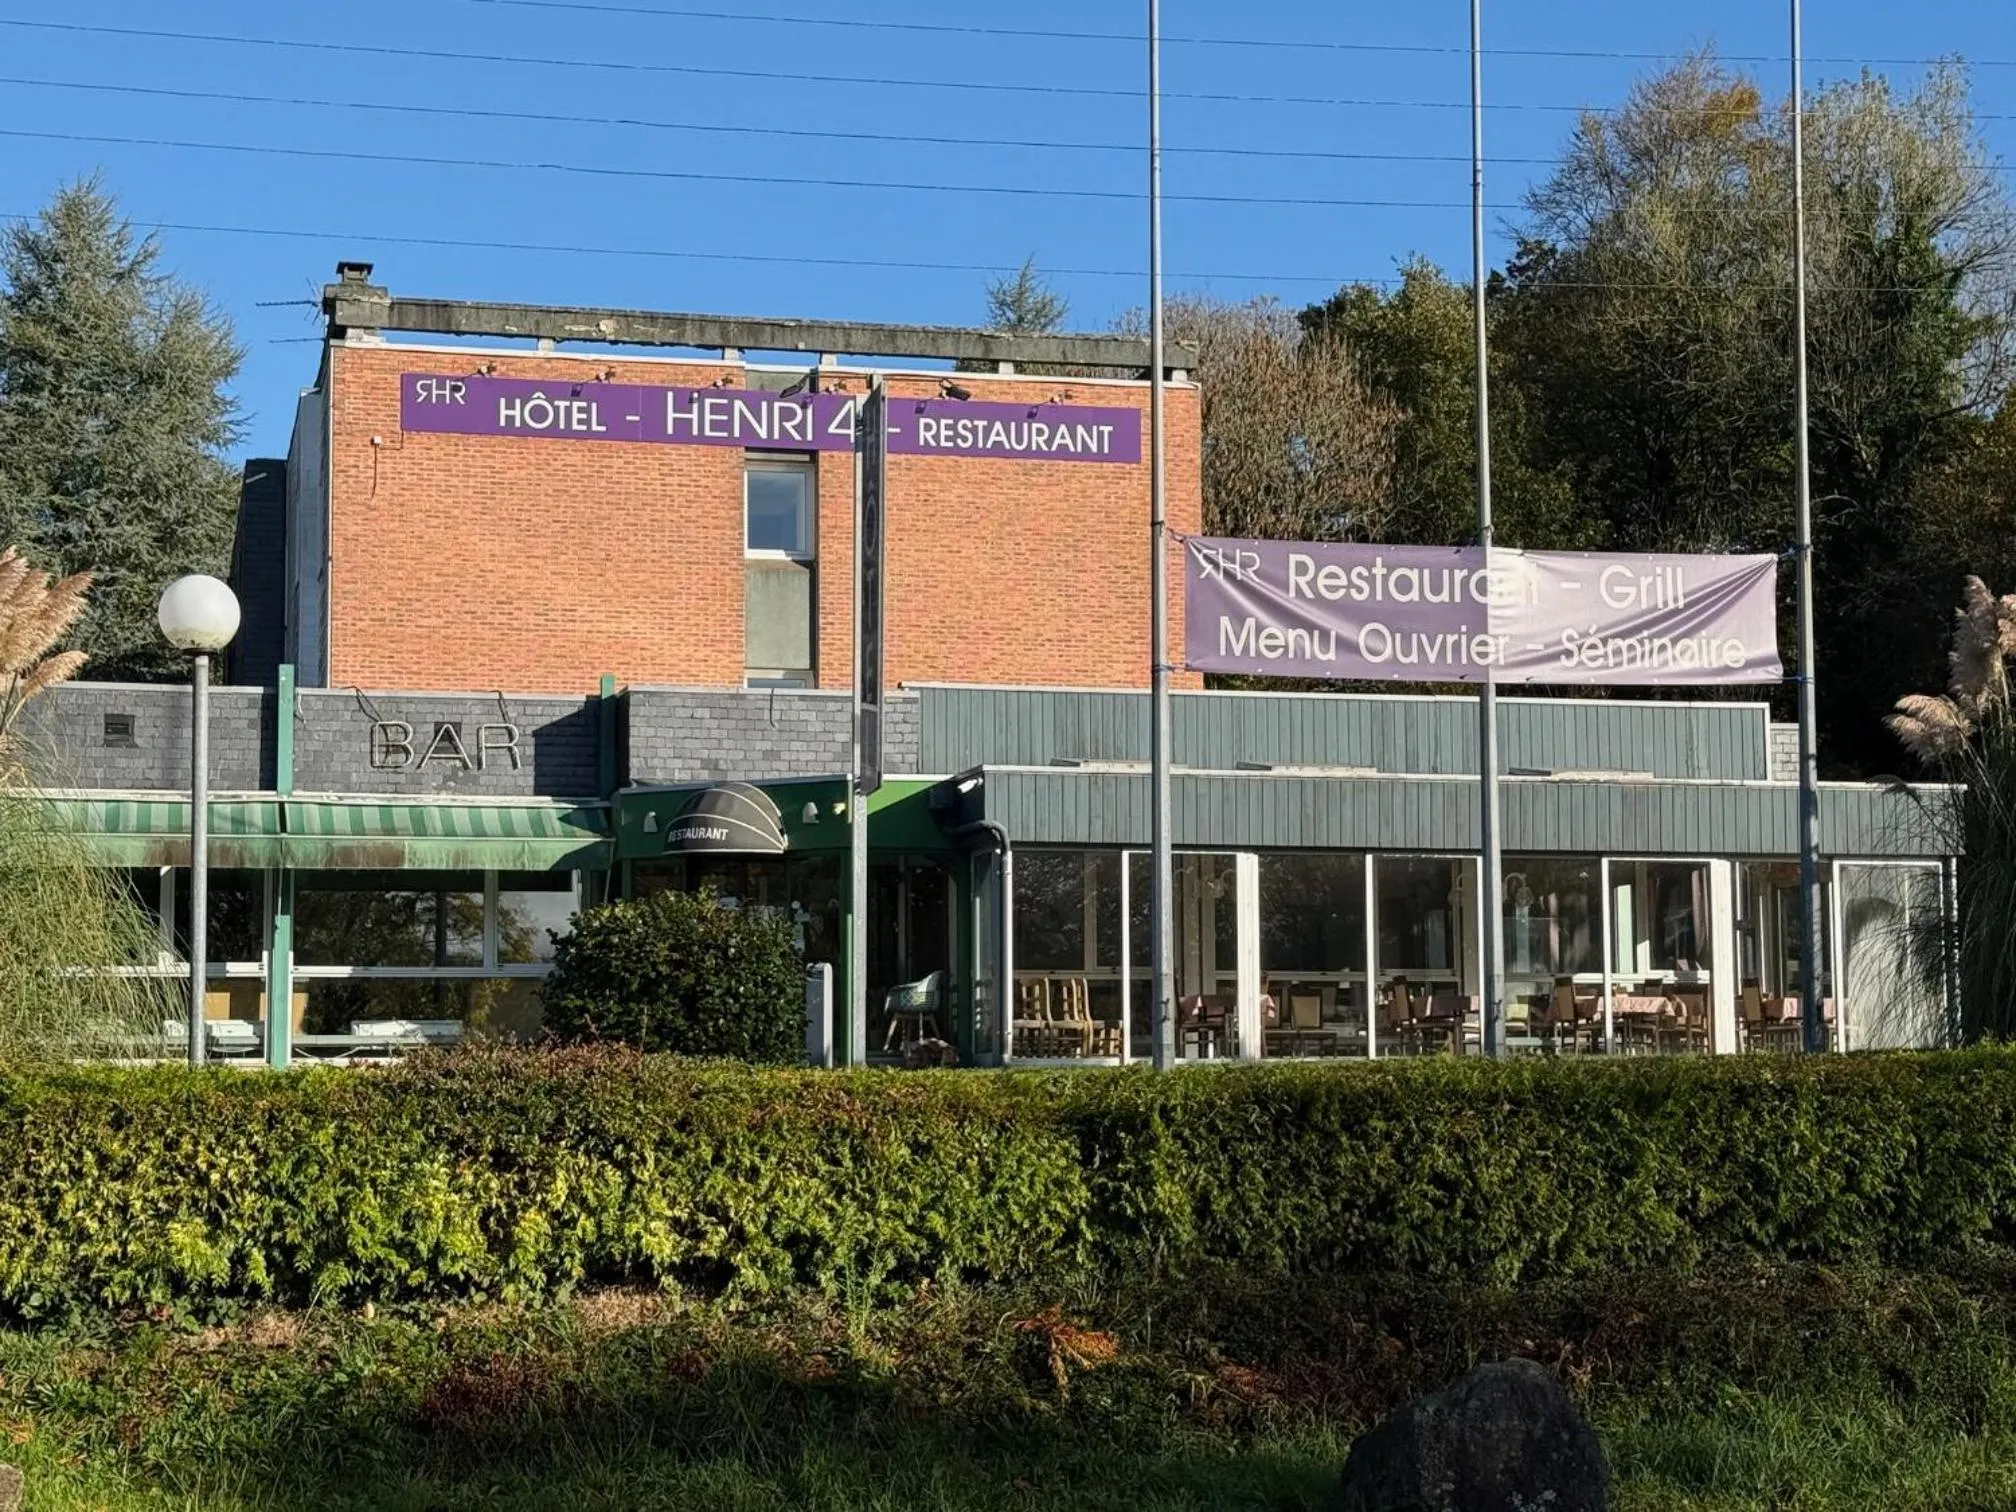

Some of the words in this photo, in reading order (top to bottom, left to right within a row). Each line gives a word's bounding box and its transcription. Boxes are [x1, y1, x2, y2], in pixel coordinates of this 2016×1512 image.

[500, 391, 606, 432] HÔTEL
[666, 391, 813, 442] HENRI
[828, 400, 855, 443] 4
[919, 417, 1113, 454] RESTAURANT
[1288, 553, 1540, 605] Restaurat
[1600, 564, 1686, 609] Grill
[1219, 616, 1337, 661] Menu
[1358, 621, 1510, 666] Ouvrier
[1560, 624, 1747, 668] Séminaire
[372, 721, 522, 770] BAR
[668, 827, 729, 843] RESTAURANT
